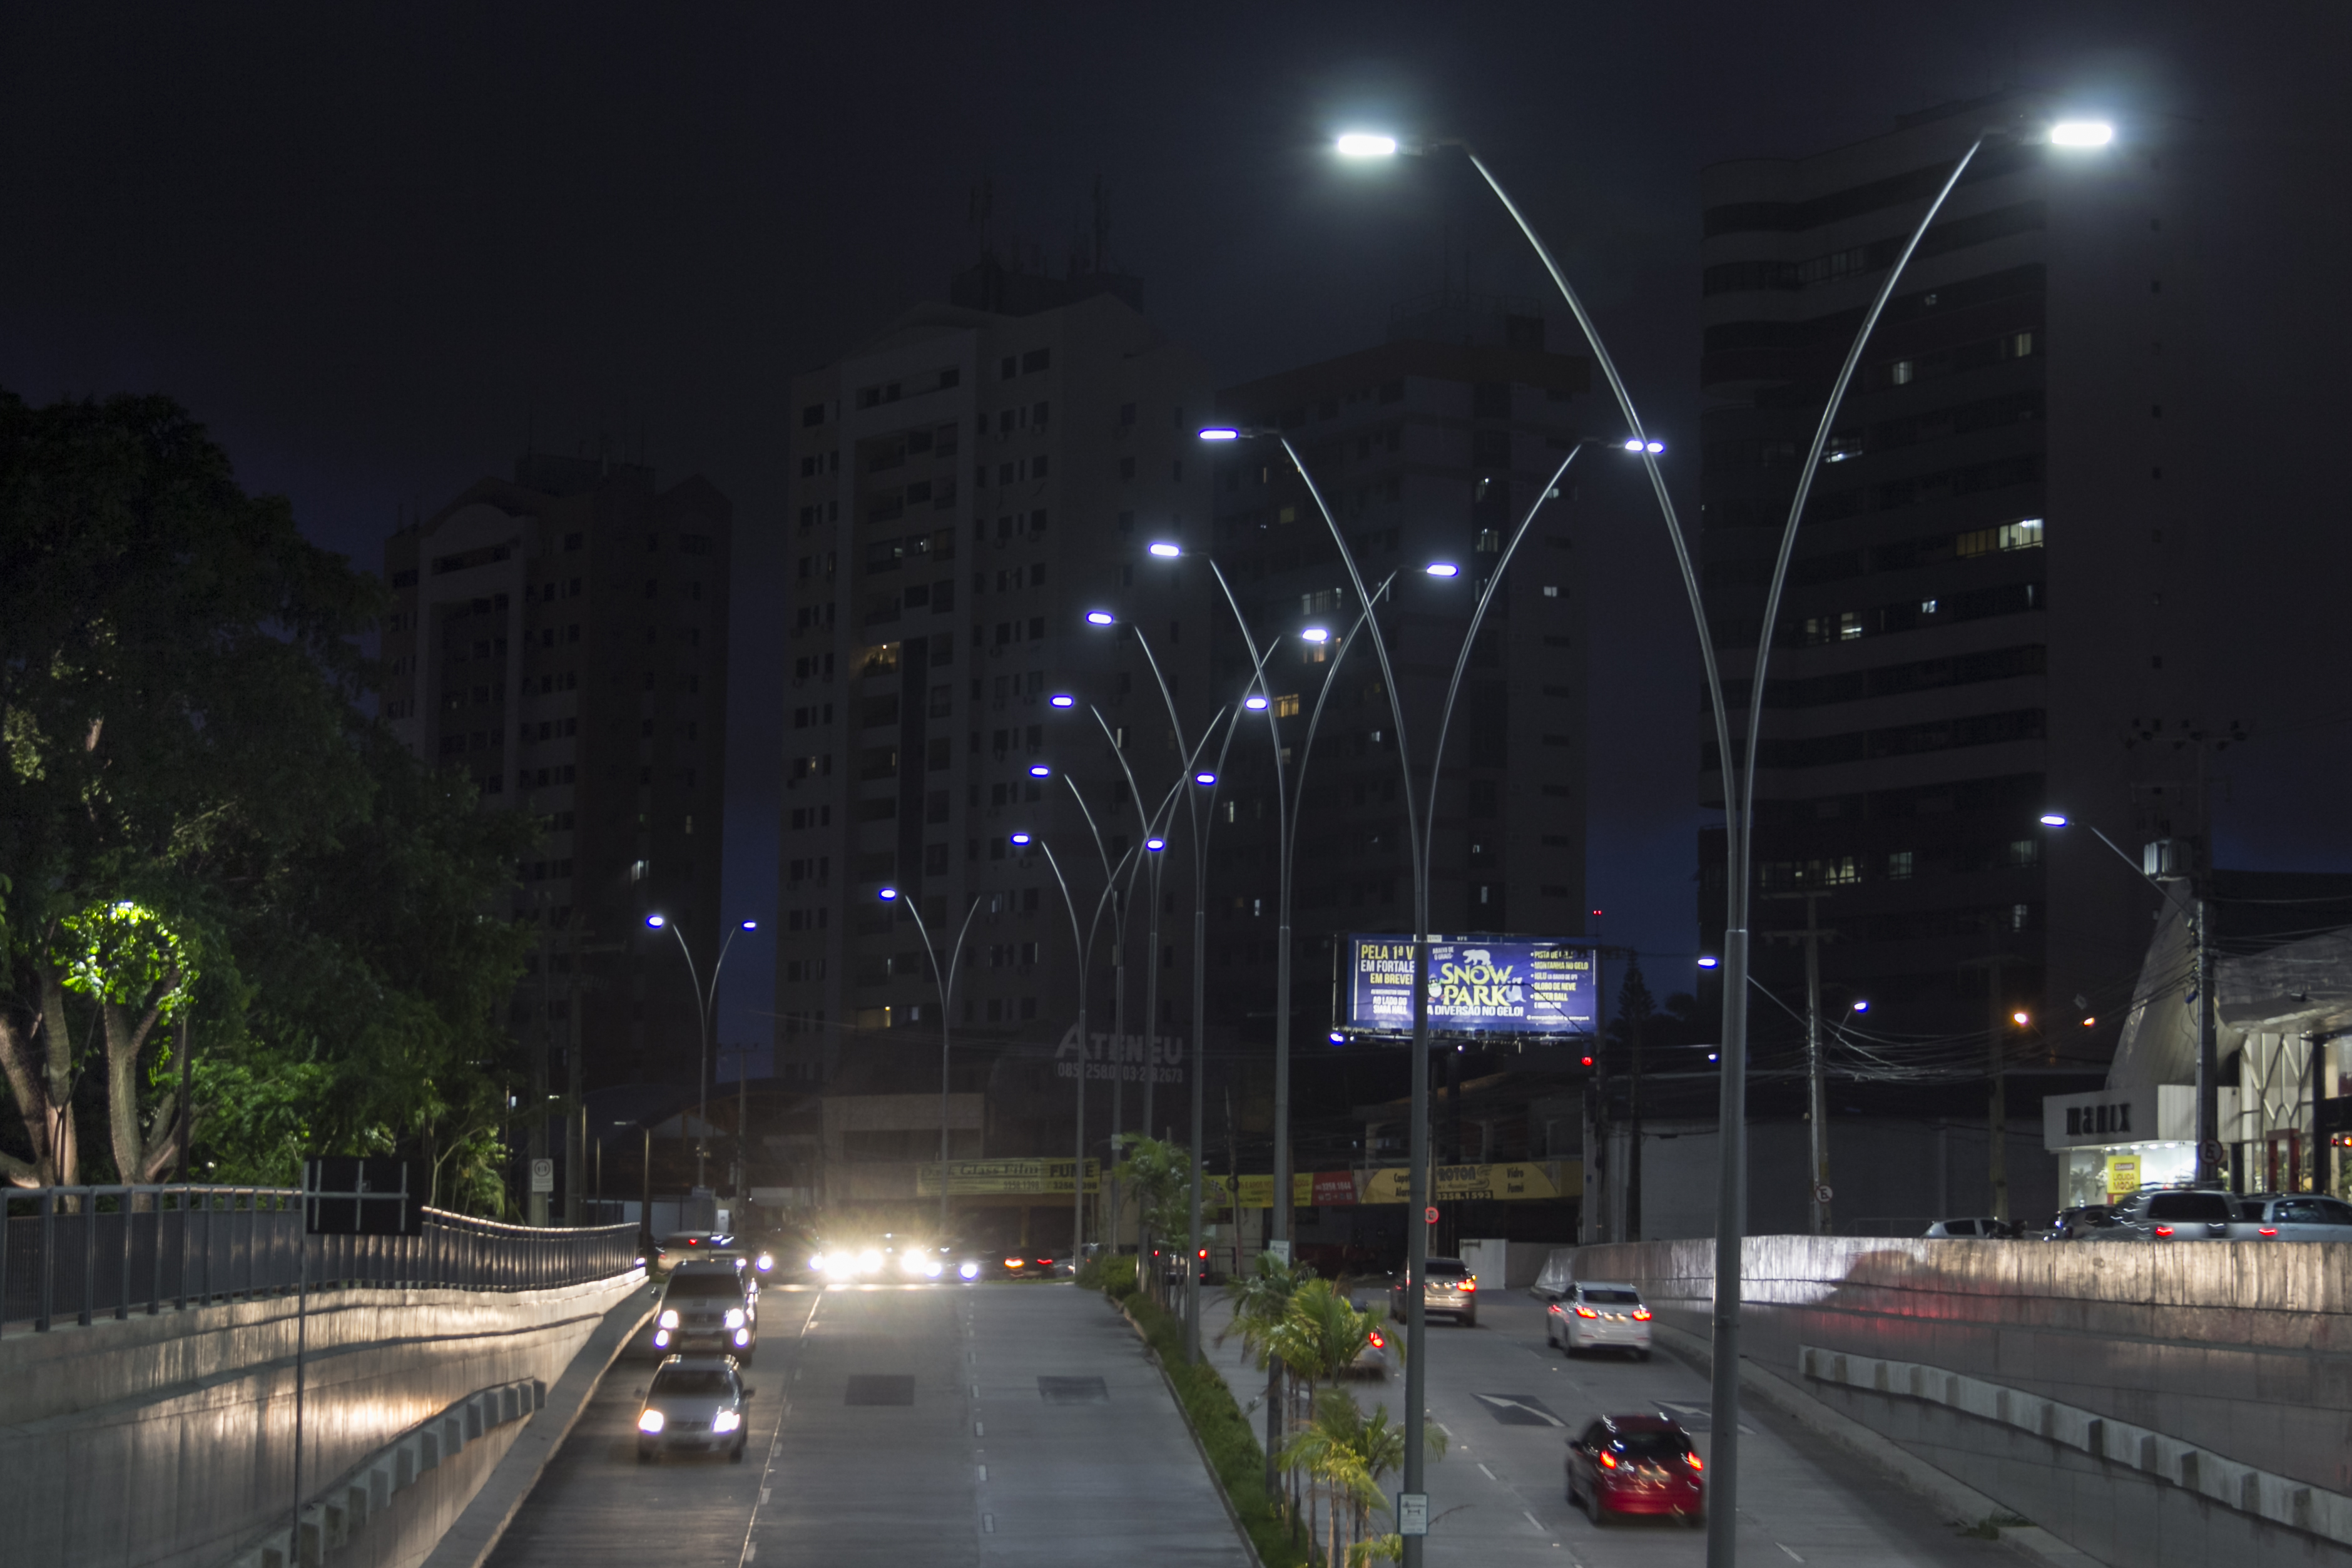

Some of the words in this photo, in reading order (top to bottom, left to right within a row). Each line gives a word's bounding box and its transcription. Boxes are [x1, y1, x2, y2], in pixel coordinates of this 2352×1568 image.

[1362, 945, 1388, 959] PELA
[1393, 945, 1403, 960] 1ª
[1361, 960, 1375, 972] EM
[1377, 960, 1415, 973] FORTALE
[1574, 962, 1589, 970] GELO
[1370, 973, 1383, 984] EM
[1384, 974, 1413, 985] BREVE!
[1441, 962, 1513, 985] SNOW
[1534, 982, 1552, 990] GLOBO
[1553, 982, 1560, 990] DE
[1561, 982, 1576, 991] NEVE
[1382, 996, 1398, 1005] LADO
[1398, 997, 1407, 1006] DO
[1443, 985, 1511, 1006] PARK
[1554, 992, 1568, 1001] BALL
[1427, 1005, 1433, 1015] A
[1482, 1006, 1495, 1016] NO
[1497, 1006, 1524, 1016] GELO!
[1055, 1022, 1183, 1064] ATENEU
[1507, 1167, 1524, 1178] Vidro
